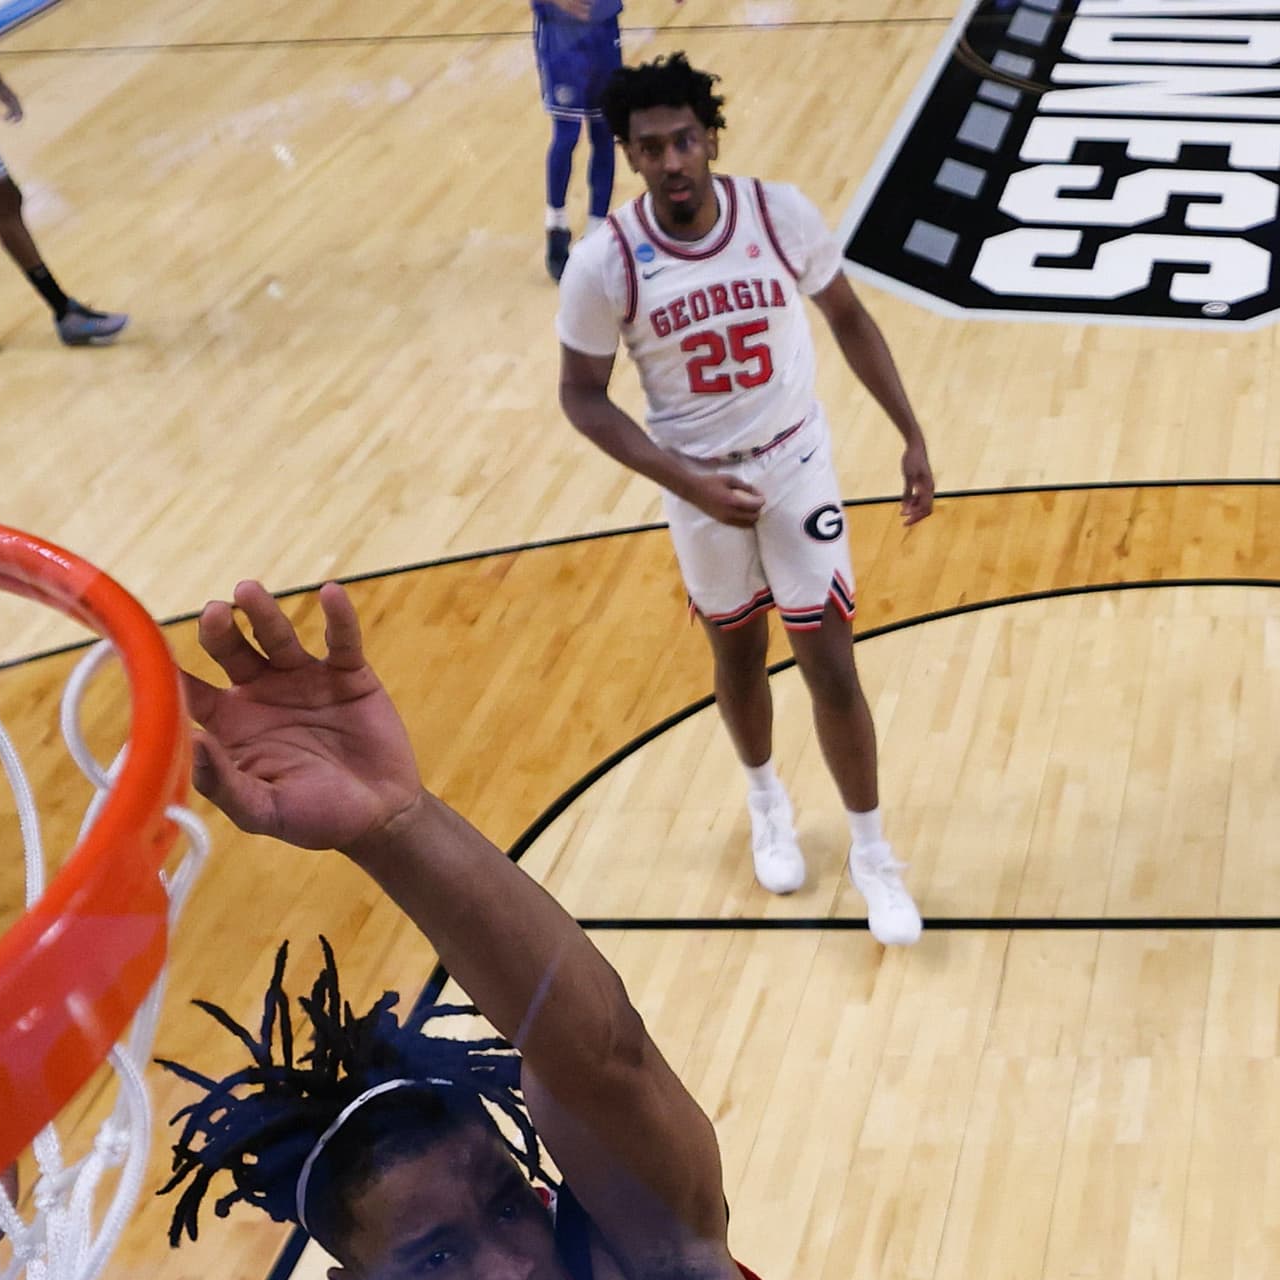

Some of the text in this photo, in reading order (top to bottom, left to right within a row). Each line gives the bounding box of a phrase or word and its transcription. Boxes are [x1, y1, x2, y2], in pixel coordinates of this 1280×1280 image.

[650, 278, 786, 338] GEORGIA
[680, 317, 774, 394] 25
[801, 502, 844, 543] G
